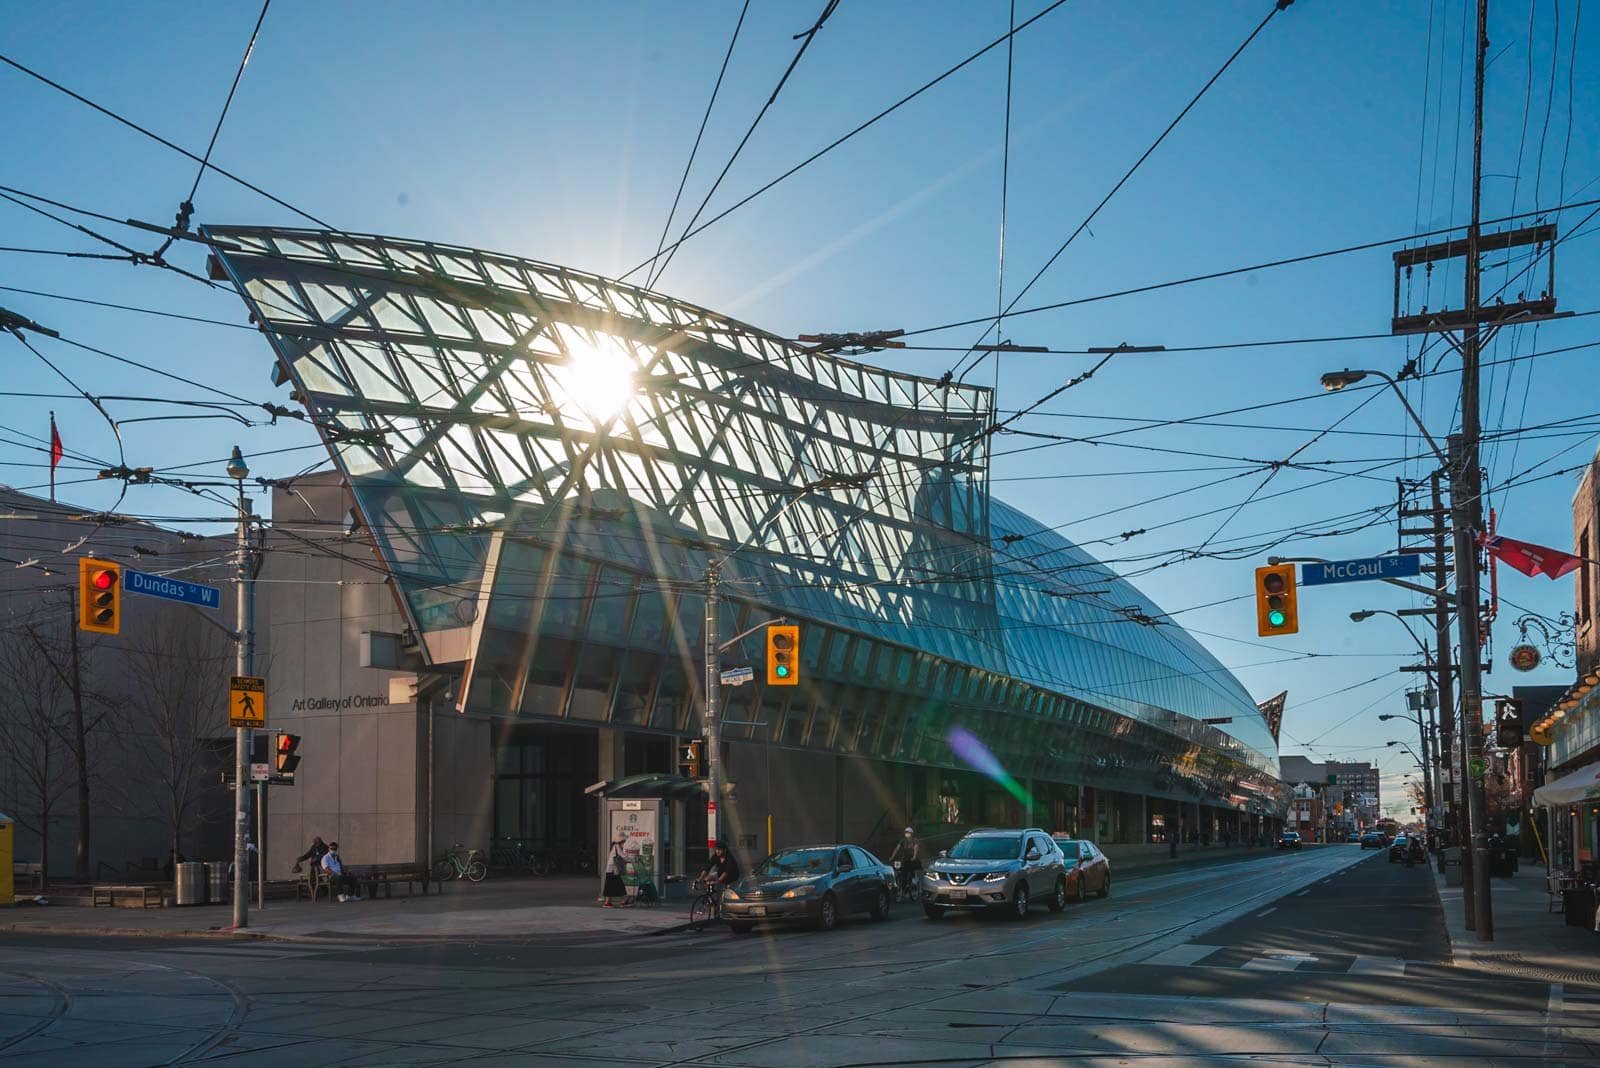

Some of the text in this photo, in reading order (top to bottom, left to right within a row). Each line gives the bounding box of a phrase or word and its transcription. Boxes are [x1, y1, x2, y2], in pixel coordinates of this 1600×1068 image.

[1323, 560, 1383, 579] McCaul
[134, 574, 185, 597] Dundas
[201, 588, 212, 602] W
[292, 698, 305, 711] Art
[307, 698, 340, 712] Gallery
[342, 696, 352, 709] of
